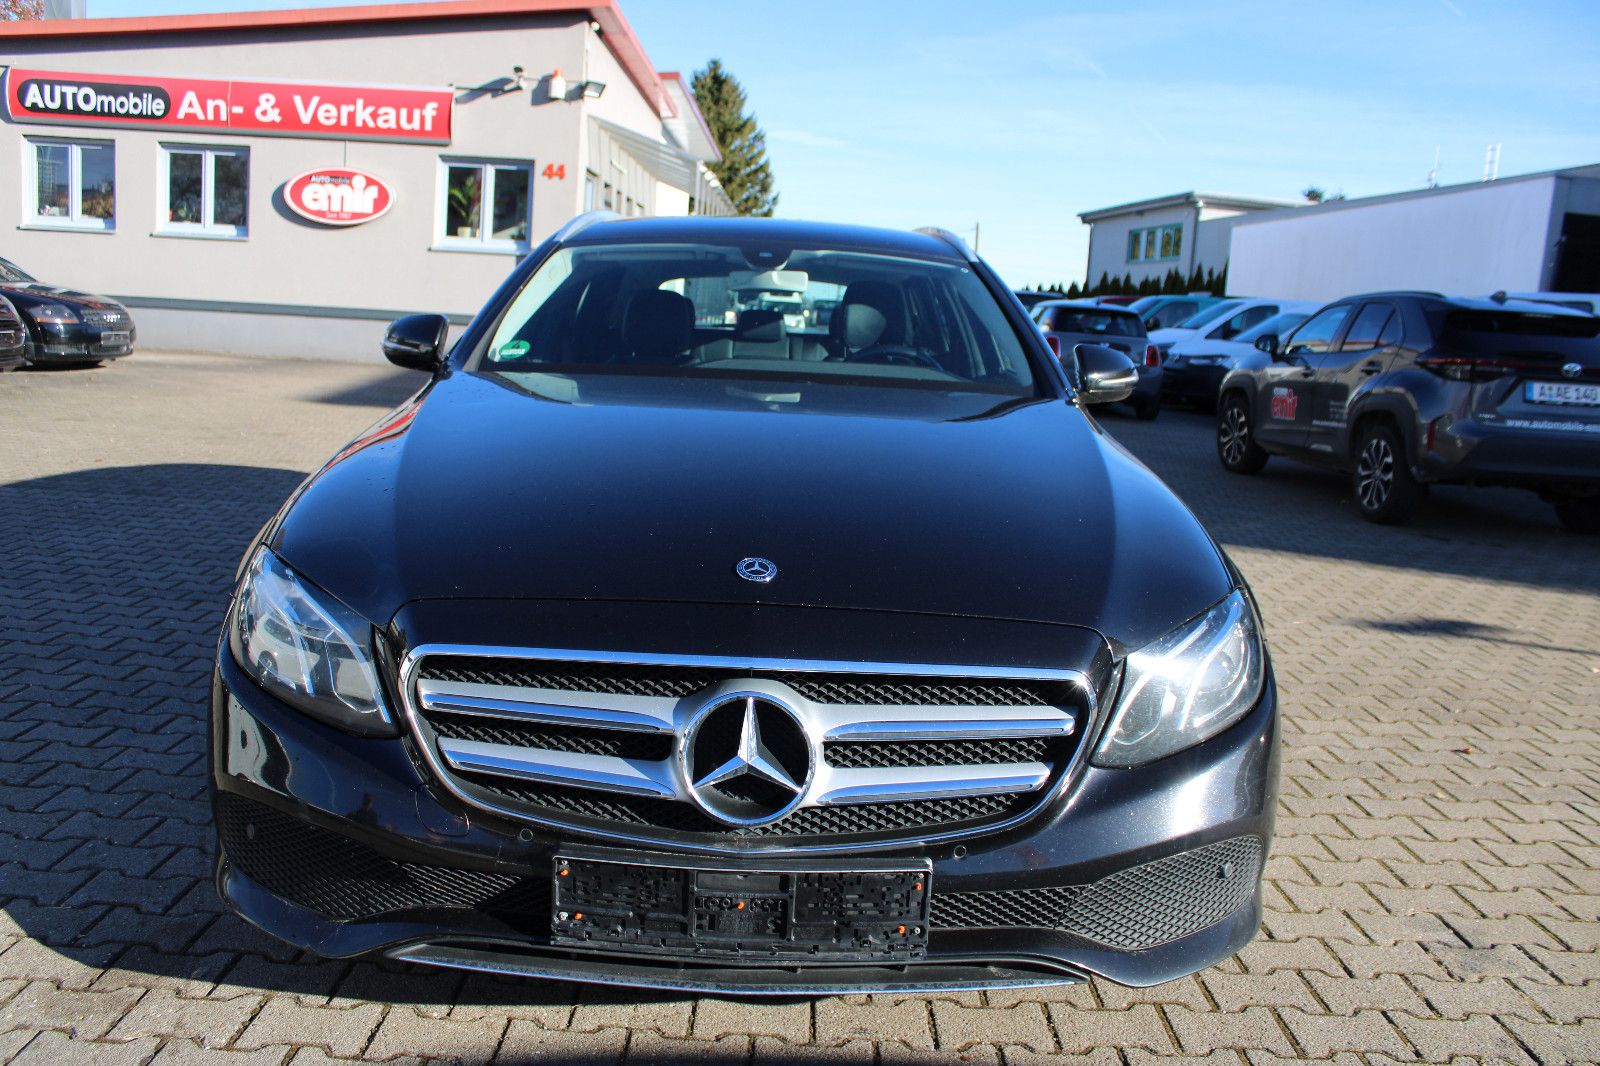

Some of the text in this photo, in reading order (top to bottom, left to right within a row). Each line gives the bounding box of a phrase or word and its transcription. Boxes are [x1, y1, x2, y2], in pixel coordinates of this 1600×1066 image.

[25, 84, 438, 131] AUTOmobile An- & Verkauf
[542, 163, 565, 180] 44
[301, 174, 379, 214] emir
